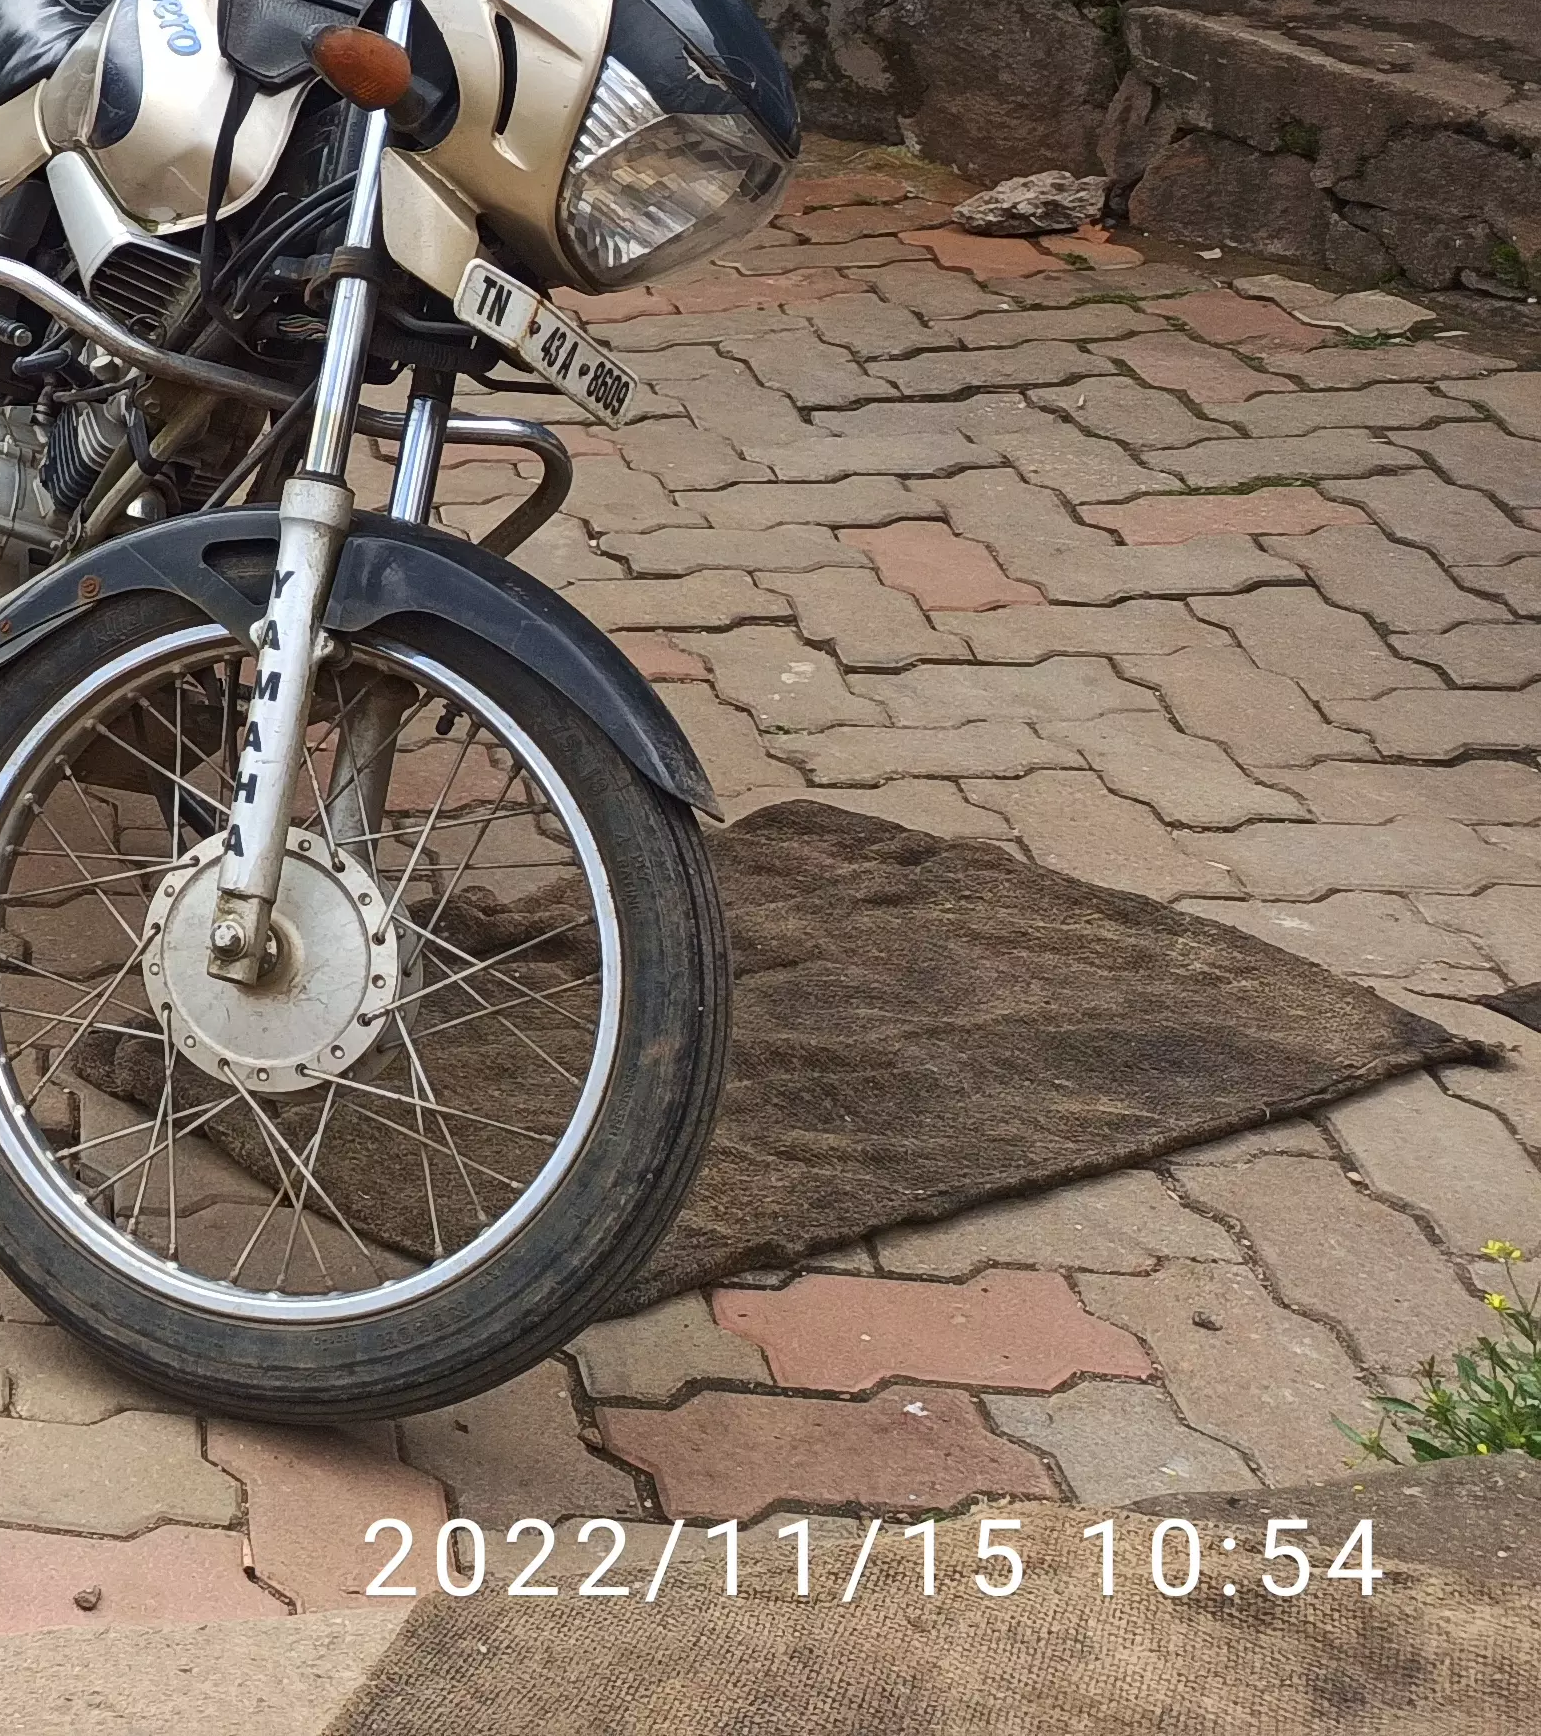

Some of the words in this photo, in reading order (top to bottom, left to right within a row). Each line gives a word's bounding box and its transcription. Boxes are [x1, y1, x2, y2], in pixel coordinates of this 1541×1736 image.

[476, 275, 512, 326] TN
[587, 361, 630, 417] 8609
[224, 569, 294, 858] YAMAHA
